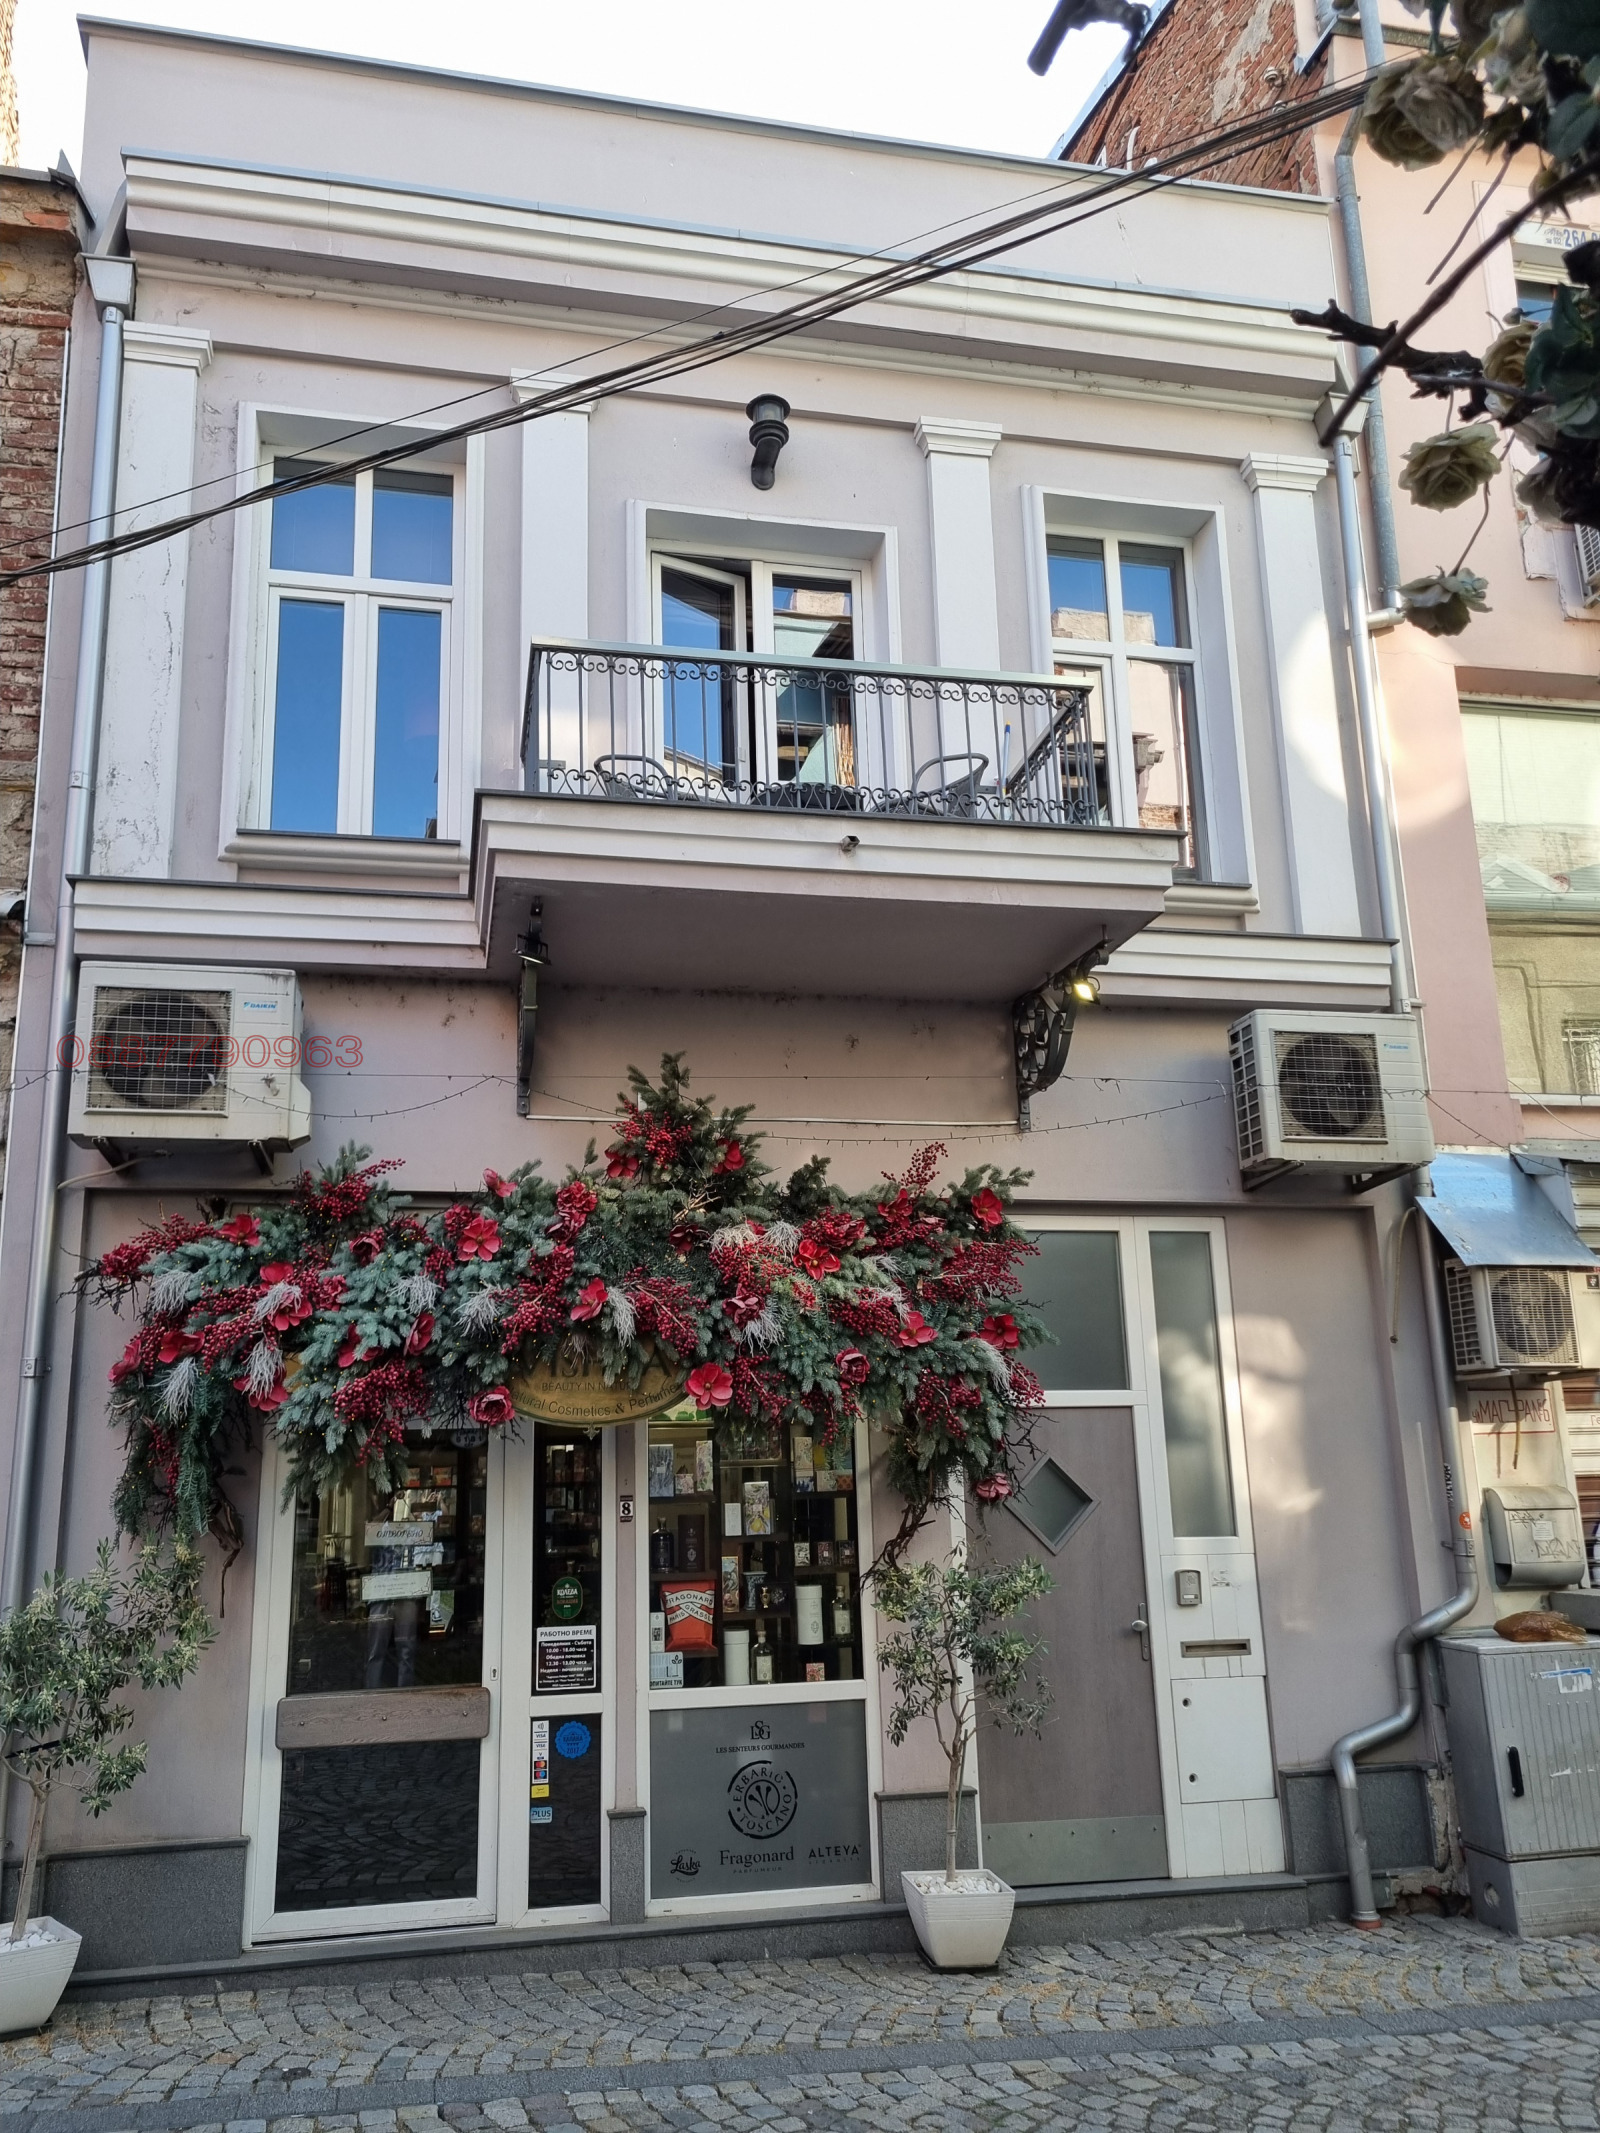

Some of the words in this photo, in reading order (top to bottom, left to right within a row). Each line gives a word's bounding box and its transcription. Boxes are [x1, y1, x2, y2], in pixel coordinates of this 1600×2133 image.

[541, 1381, 583, 1391] BEAUTY
[584, 1381, 595, 1391] IN
[549, 1402, 611, 1416] Cosmetics
[614, 1402, 626, 1414] &
[621, 1502, 631, 1516] 8
[669, 1610, 686, 1623] PARIS
[540, 1630, 570, 1638] РАБОТНО
[715, 1746, 727, 1754] LES
[728, 1744, 760, 1753] SENTEURS
[761, 1742, 805, 1751] GOURMANDES
[739, 1794, 792, 1833] TOSCANO
[719, 1846, 795, 1868] Fragonard
[808, 1844, 859, 1859] ALTEYA
[670, 1854, 701, 1876] Laska
